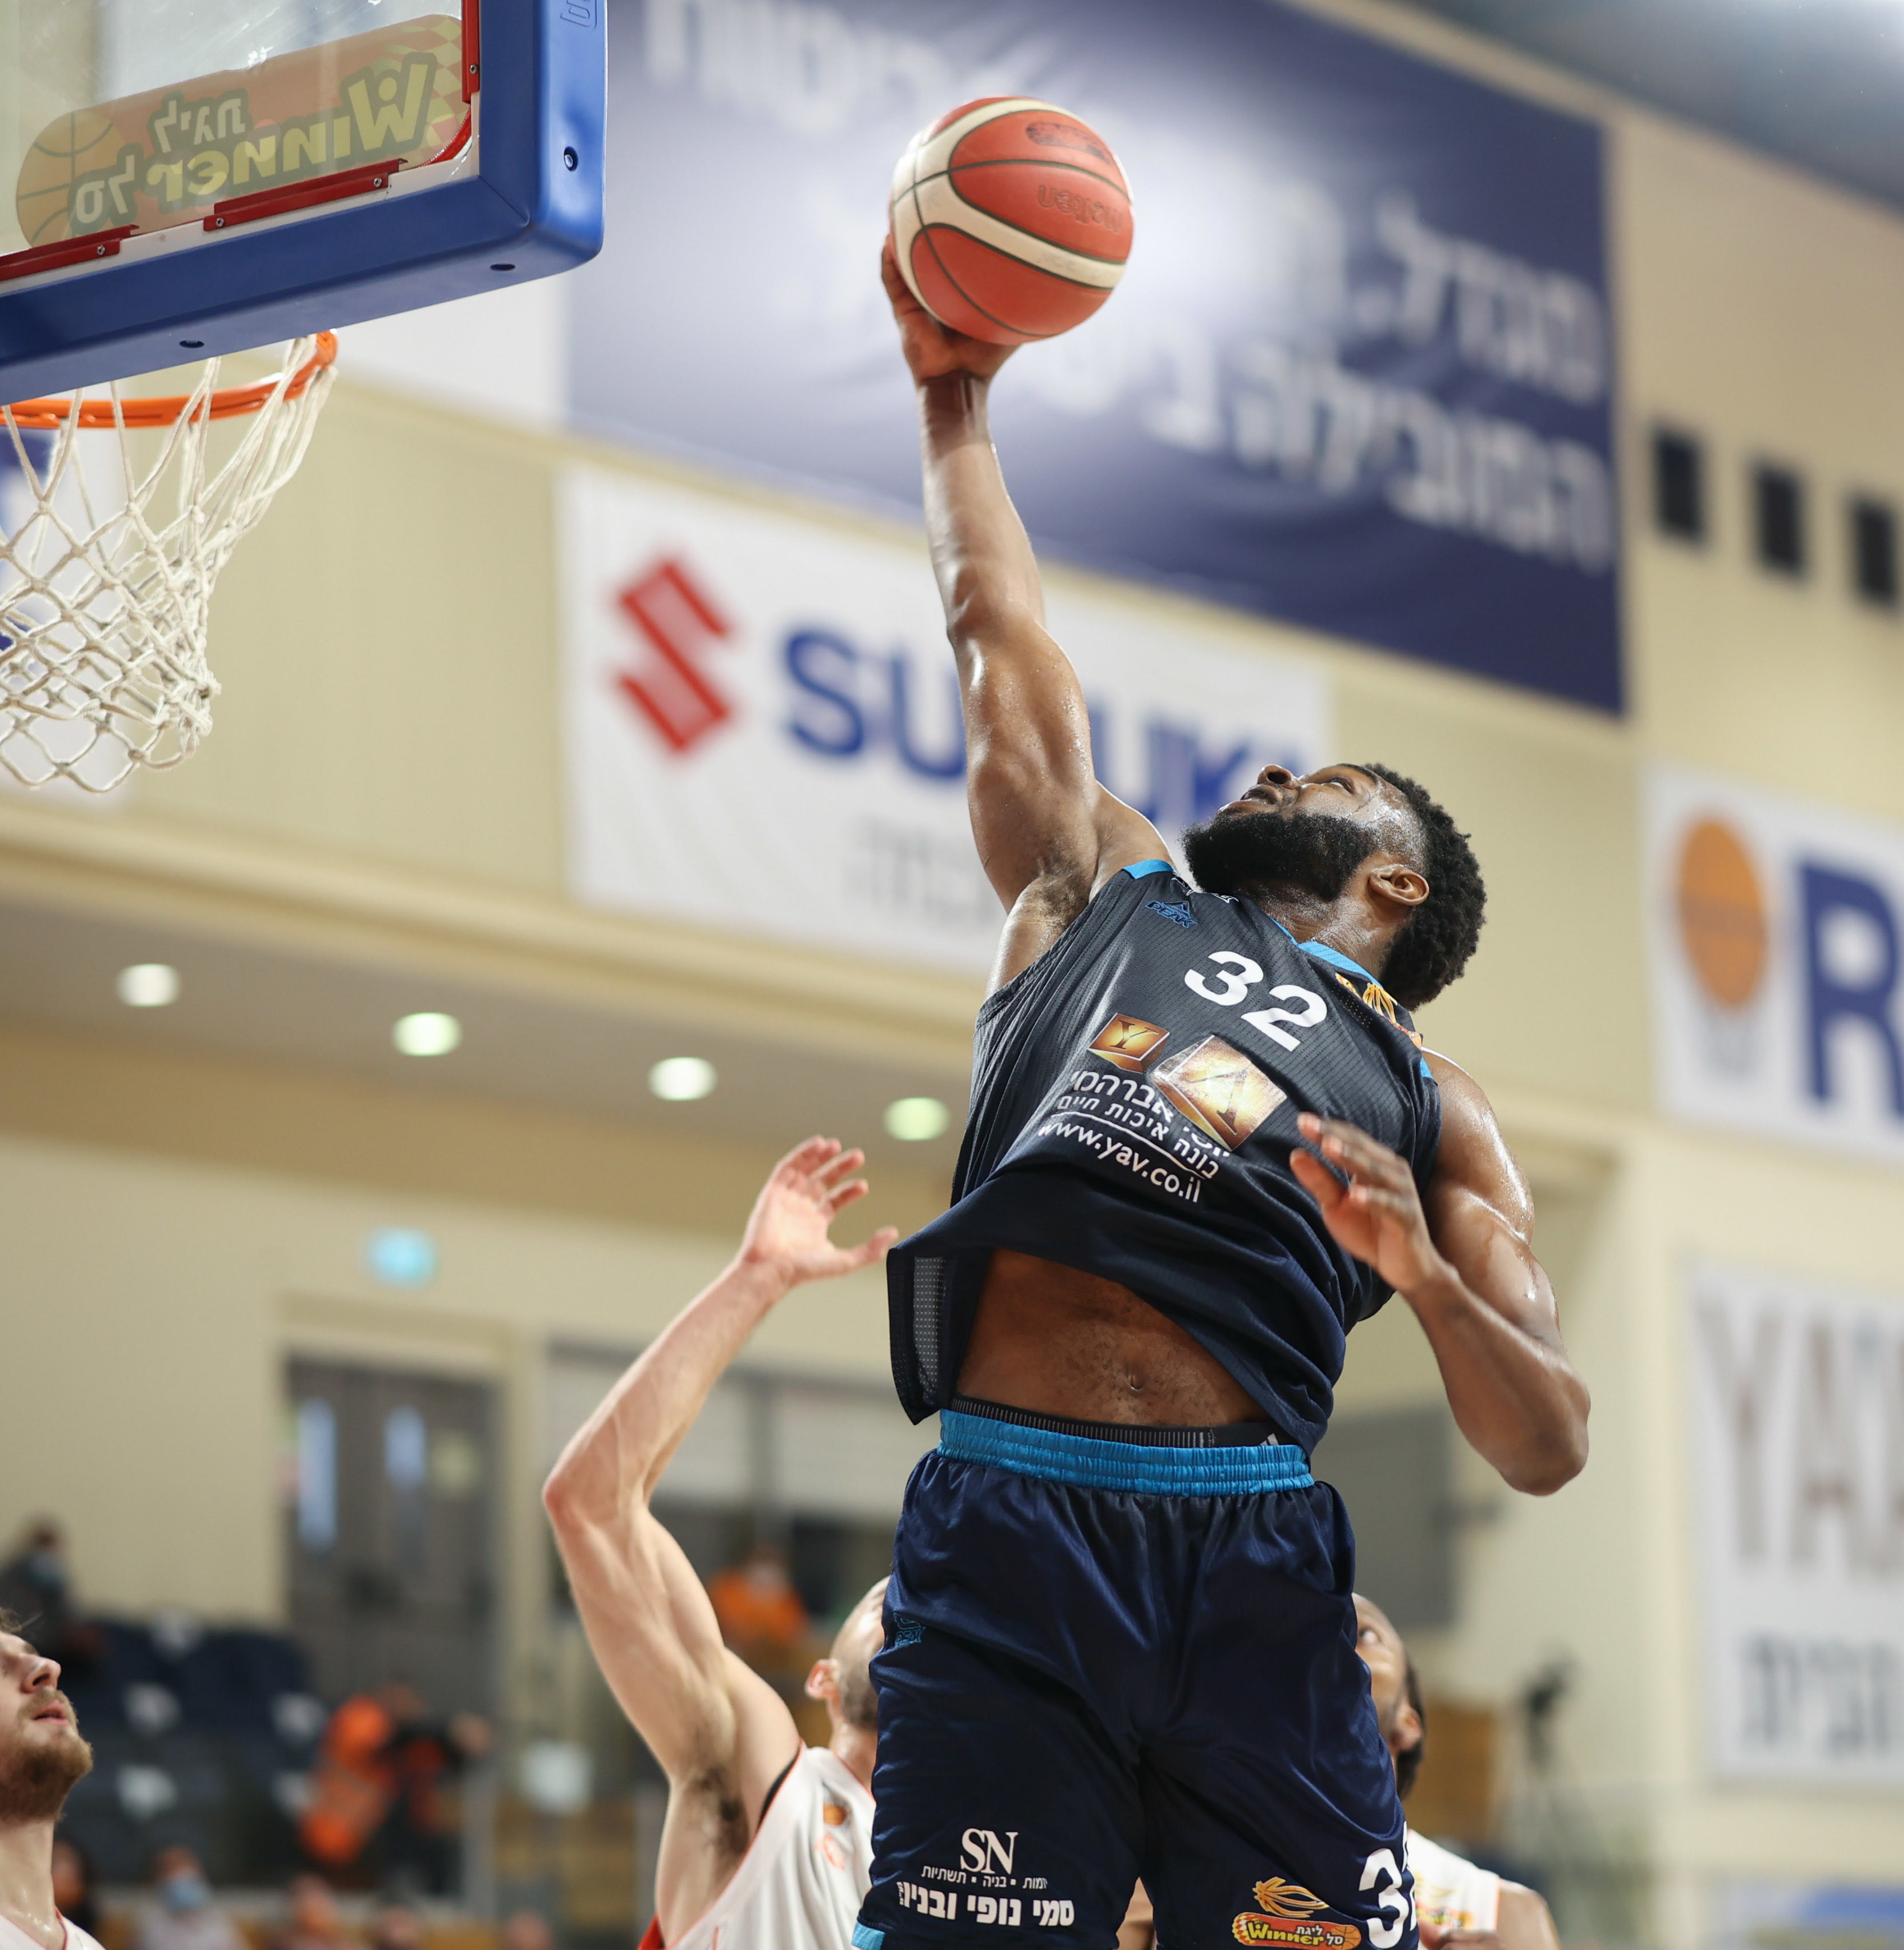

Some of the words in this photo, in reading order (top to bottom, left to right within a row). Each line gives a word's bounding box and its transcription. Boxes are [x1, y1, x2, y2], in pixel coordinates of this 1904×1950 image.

[1145, 901, 1198, 928] PEAK
[1184, 951, 1327, 1052] 32
[1109, 1019, 1159, 1050] Y
[1057, 1096, 1100, 1110] חיים
[1104, 1103, 1169, 1141] איכות
[1038, 1122, 1201, 1202] www.yav.co.il
[1173, 1138, 1219, 1178] בונה
[960, 1828, 1019, 1875] SN
[921, 1865, 967, 1884] תשתיות
[983, 1875, 1007, 1888] בניה
[1359, 1821, 1417, 1949] 3
[967, 1895, 1022, 1927] נופי
[1032, 1899, 1075, 1927] סמי
[1296, 1925, 1323, 1936] ליגת
[1327, 1933, 1344, 1946] סל
